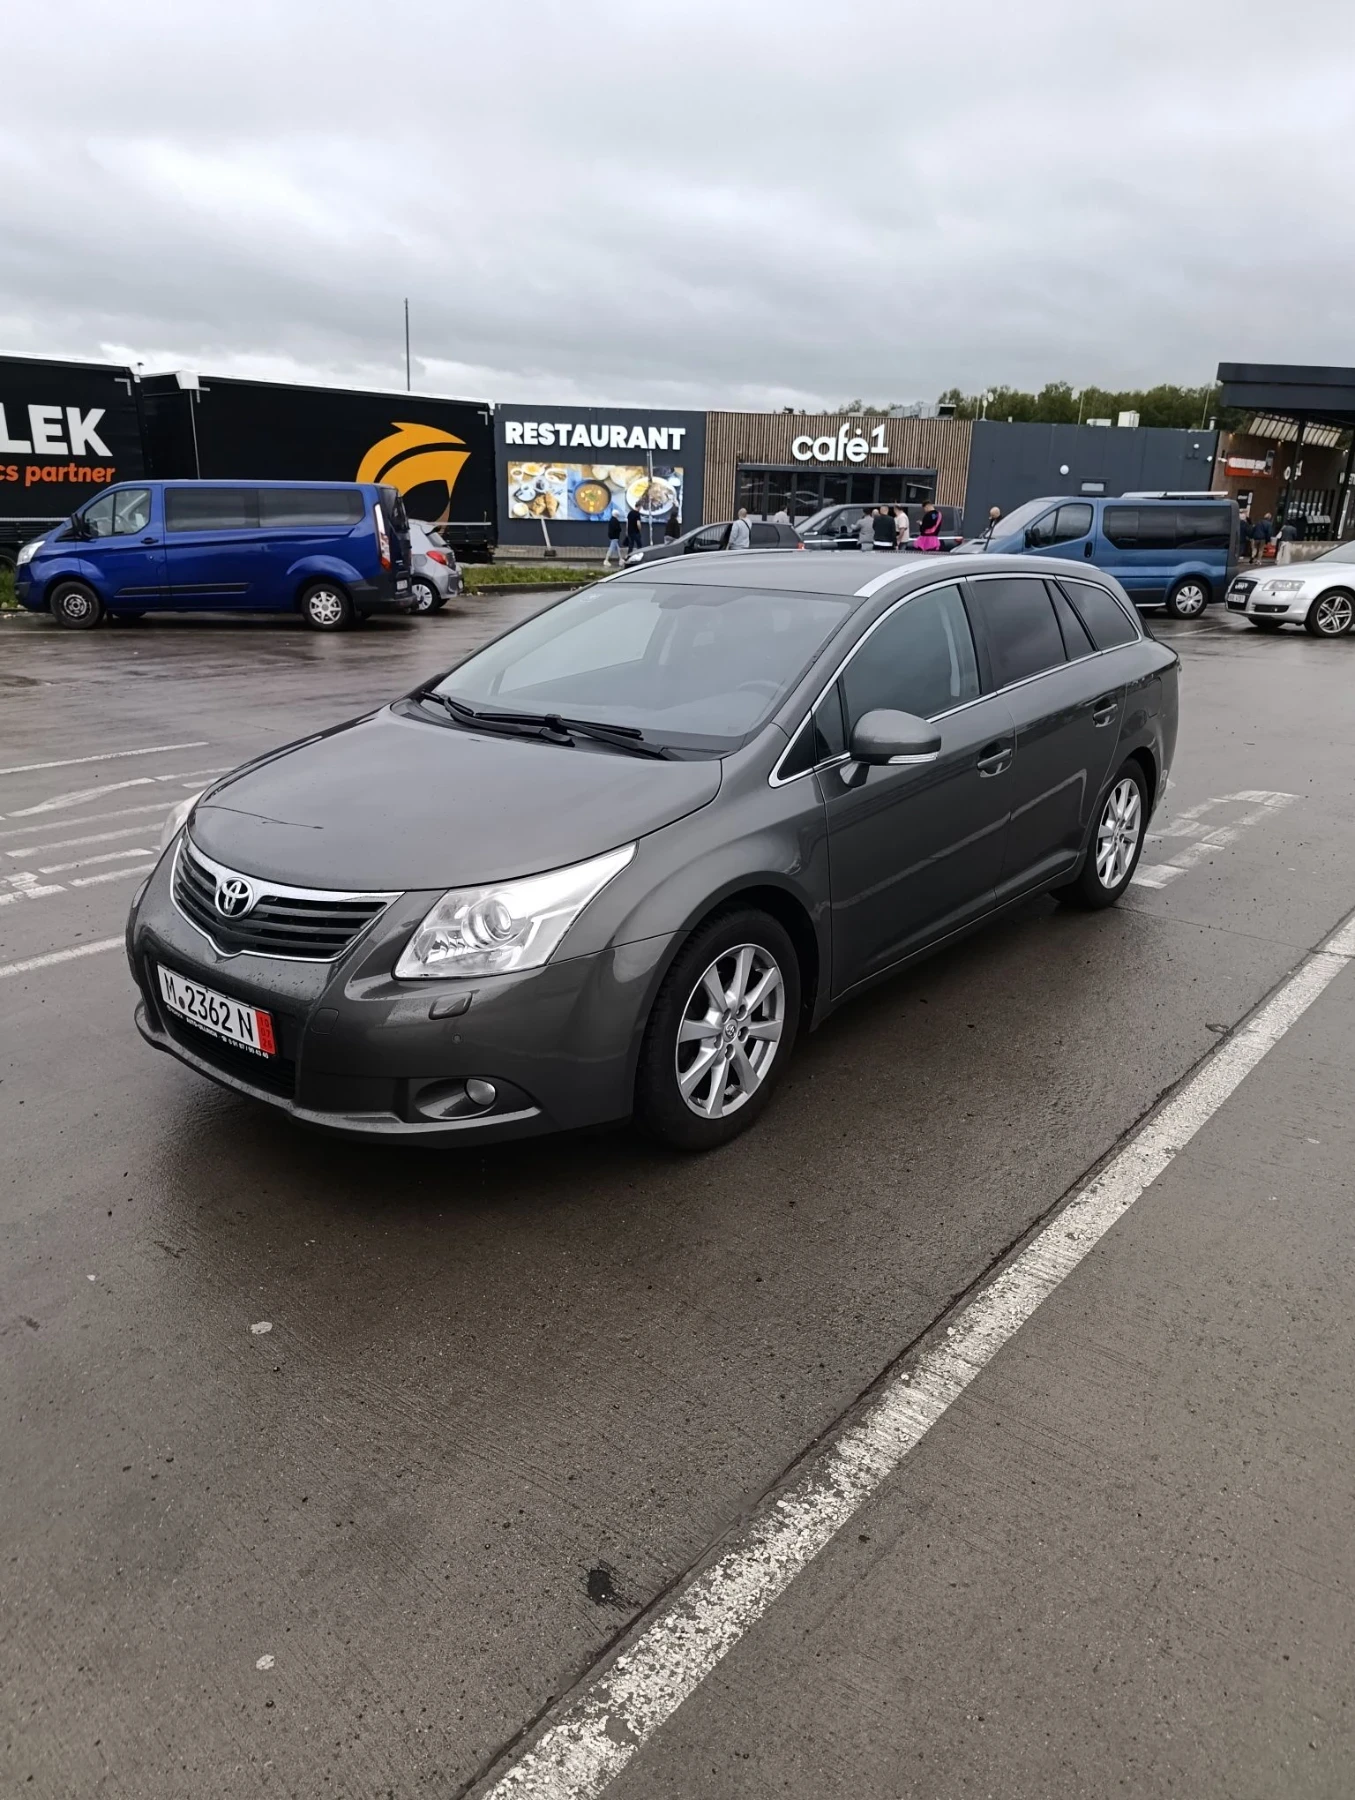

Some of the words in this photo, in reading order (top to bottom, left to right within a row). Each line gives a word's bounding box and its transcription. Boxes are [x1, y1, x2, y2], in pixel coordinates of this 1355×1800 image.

[0, 402, 113, 457] LEK
[505, 421, 686, 450] RESTAURANT
[25, 462, 116, 487] partner
